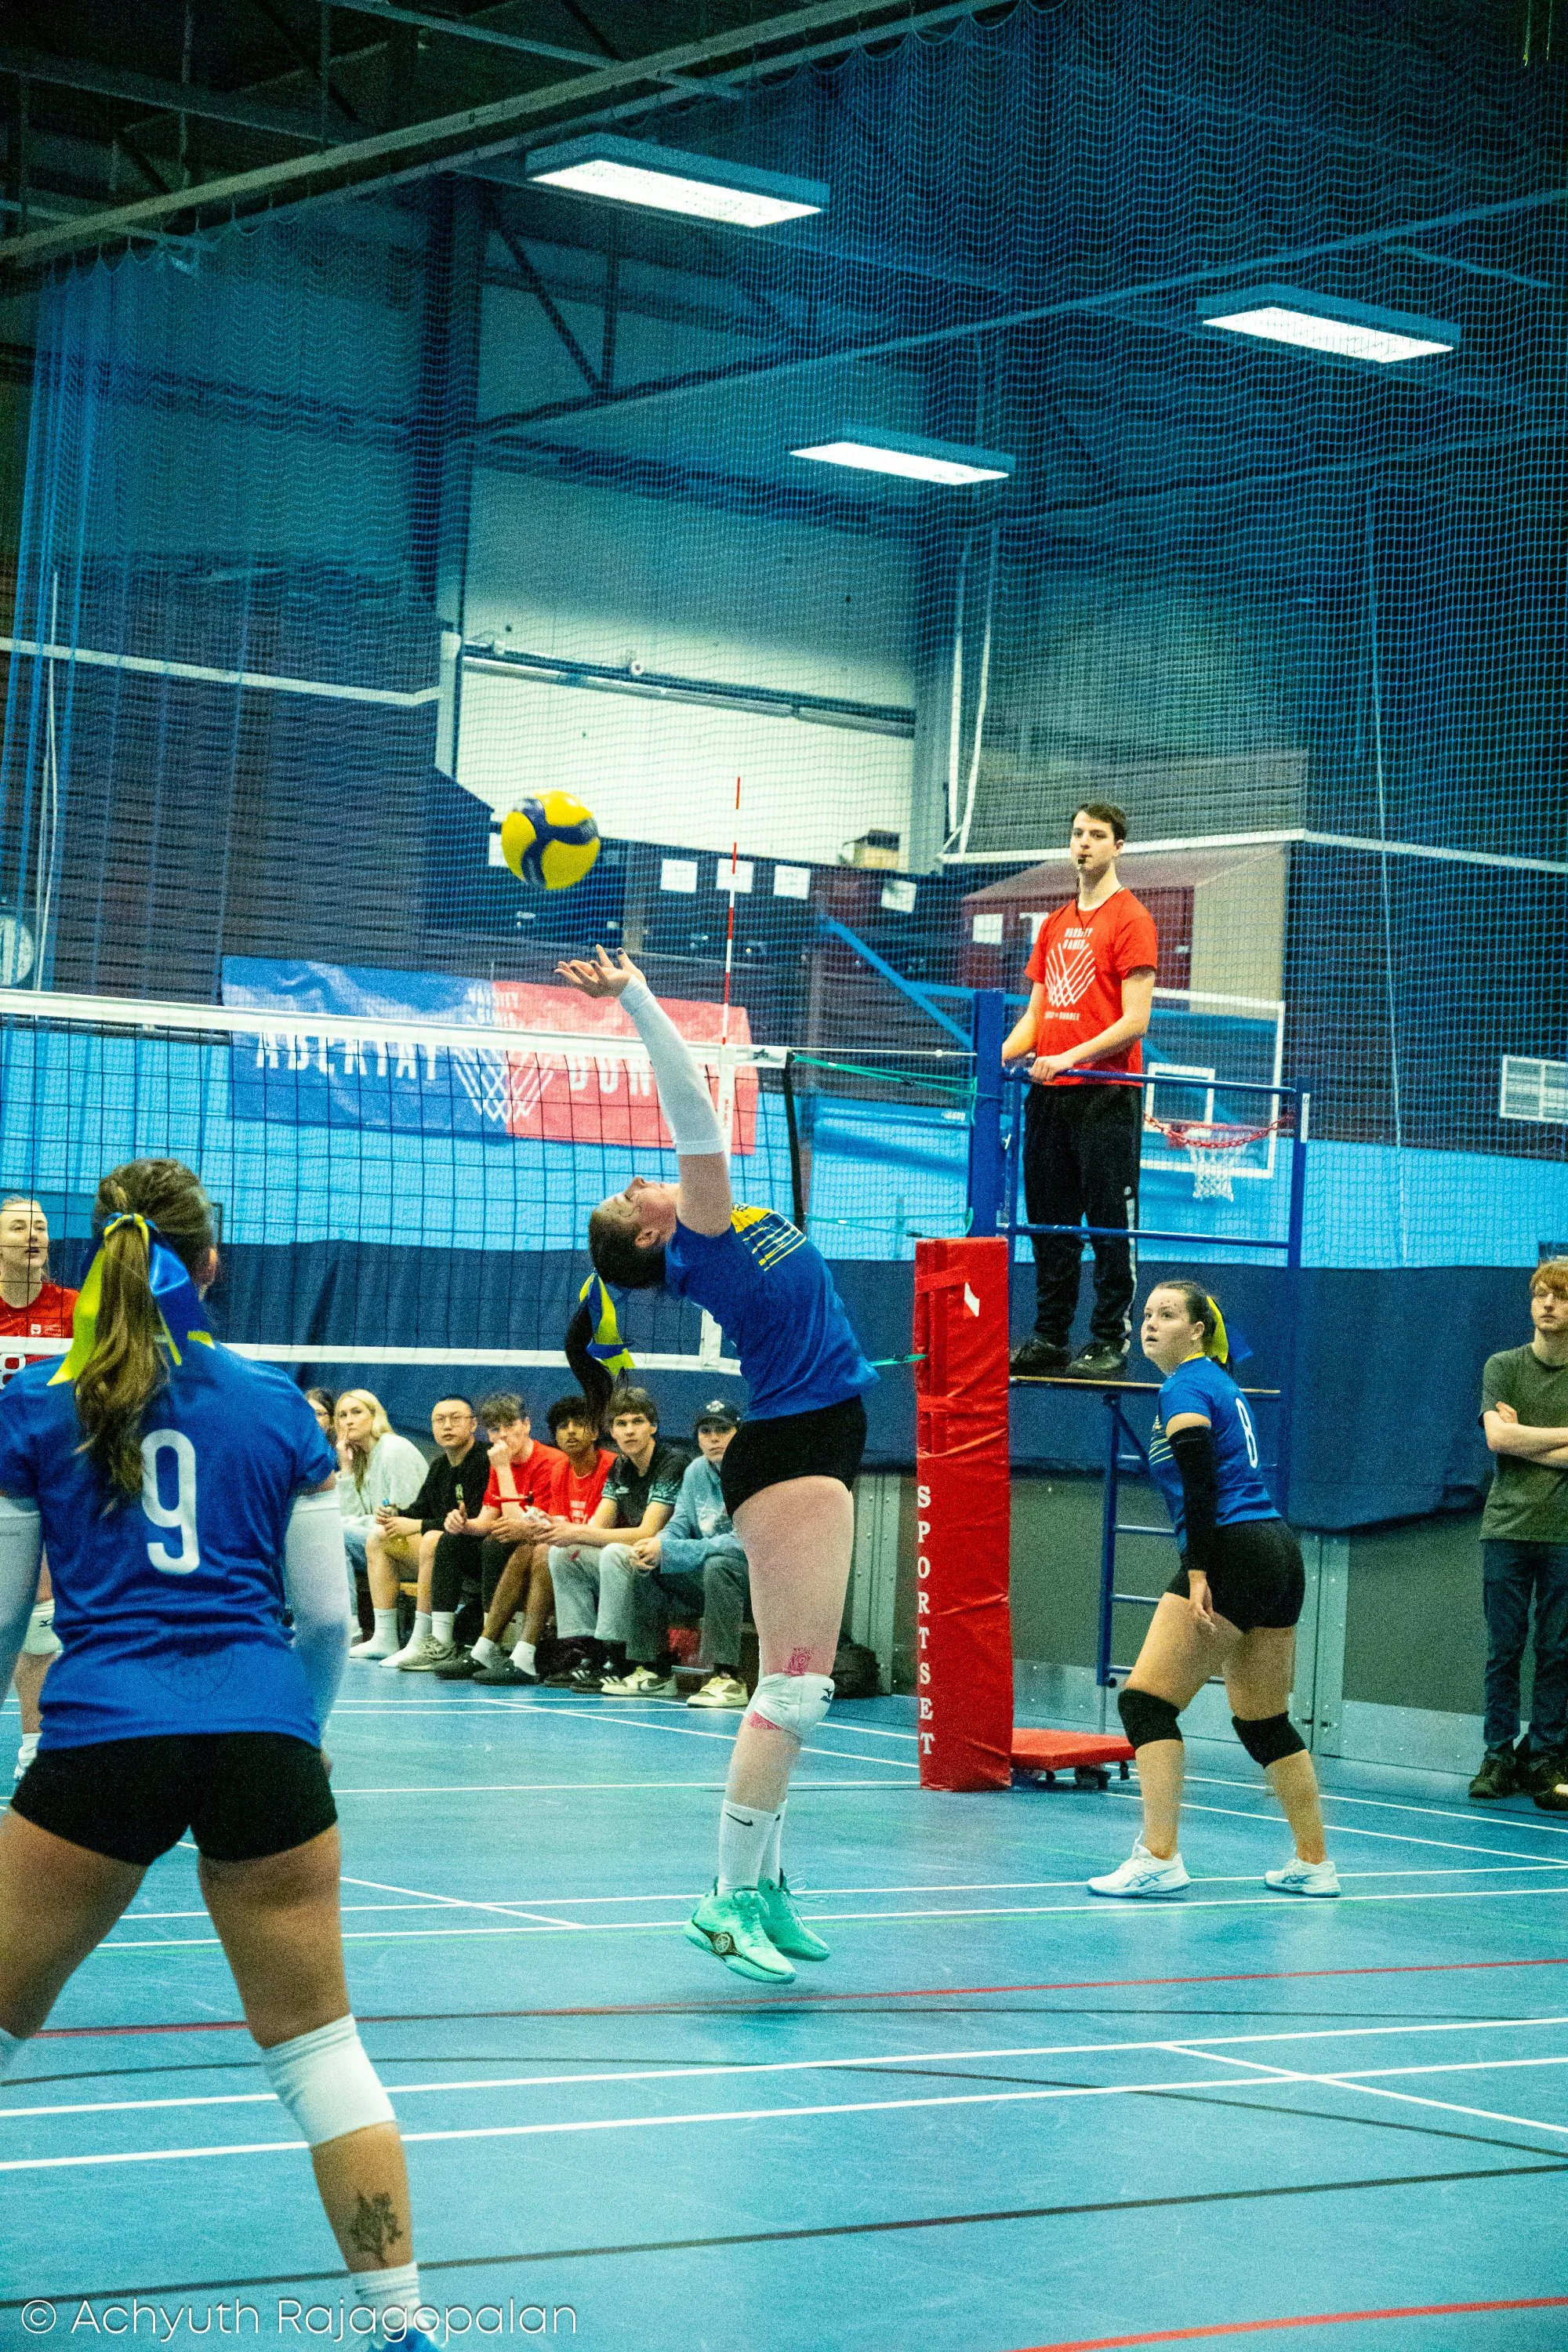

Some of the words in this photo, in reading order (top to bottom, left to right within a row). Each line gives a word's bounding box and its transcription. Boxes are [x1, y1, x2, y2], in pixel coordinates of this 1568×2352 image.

[140, 1429, 201, 1576] 9
[1235, 1397, 1258, 1468] 8
[917, 1486, 935, 1755] SPORTSET
